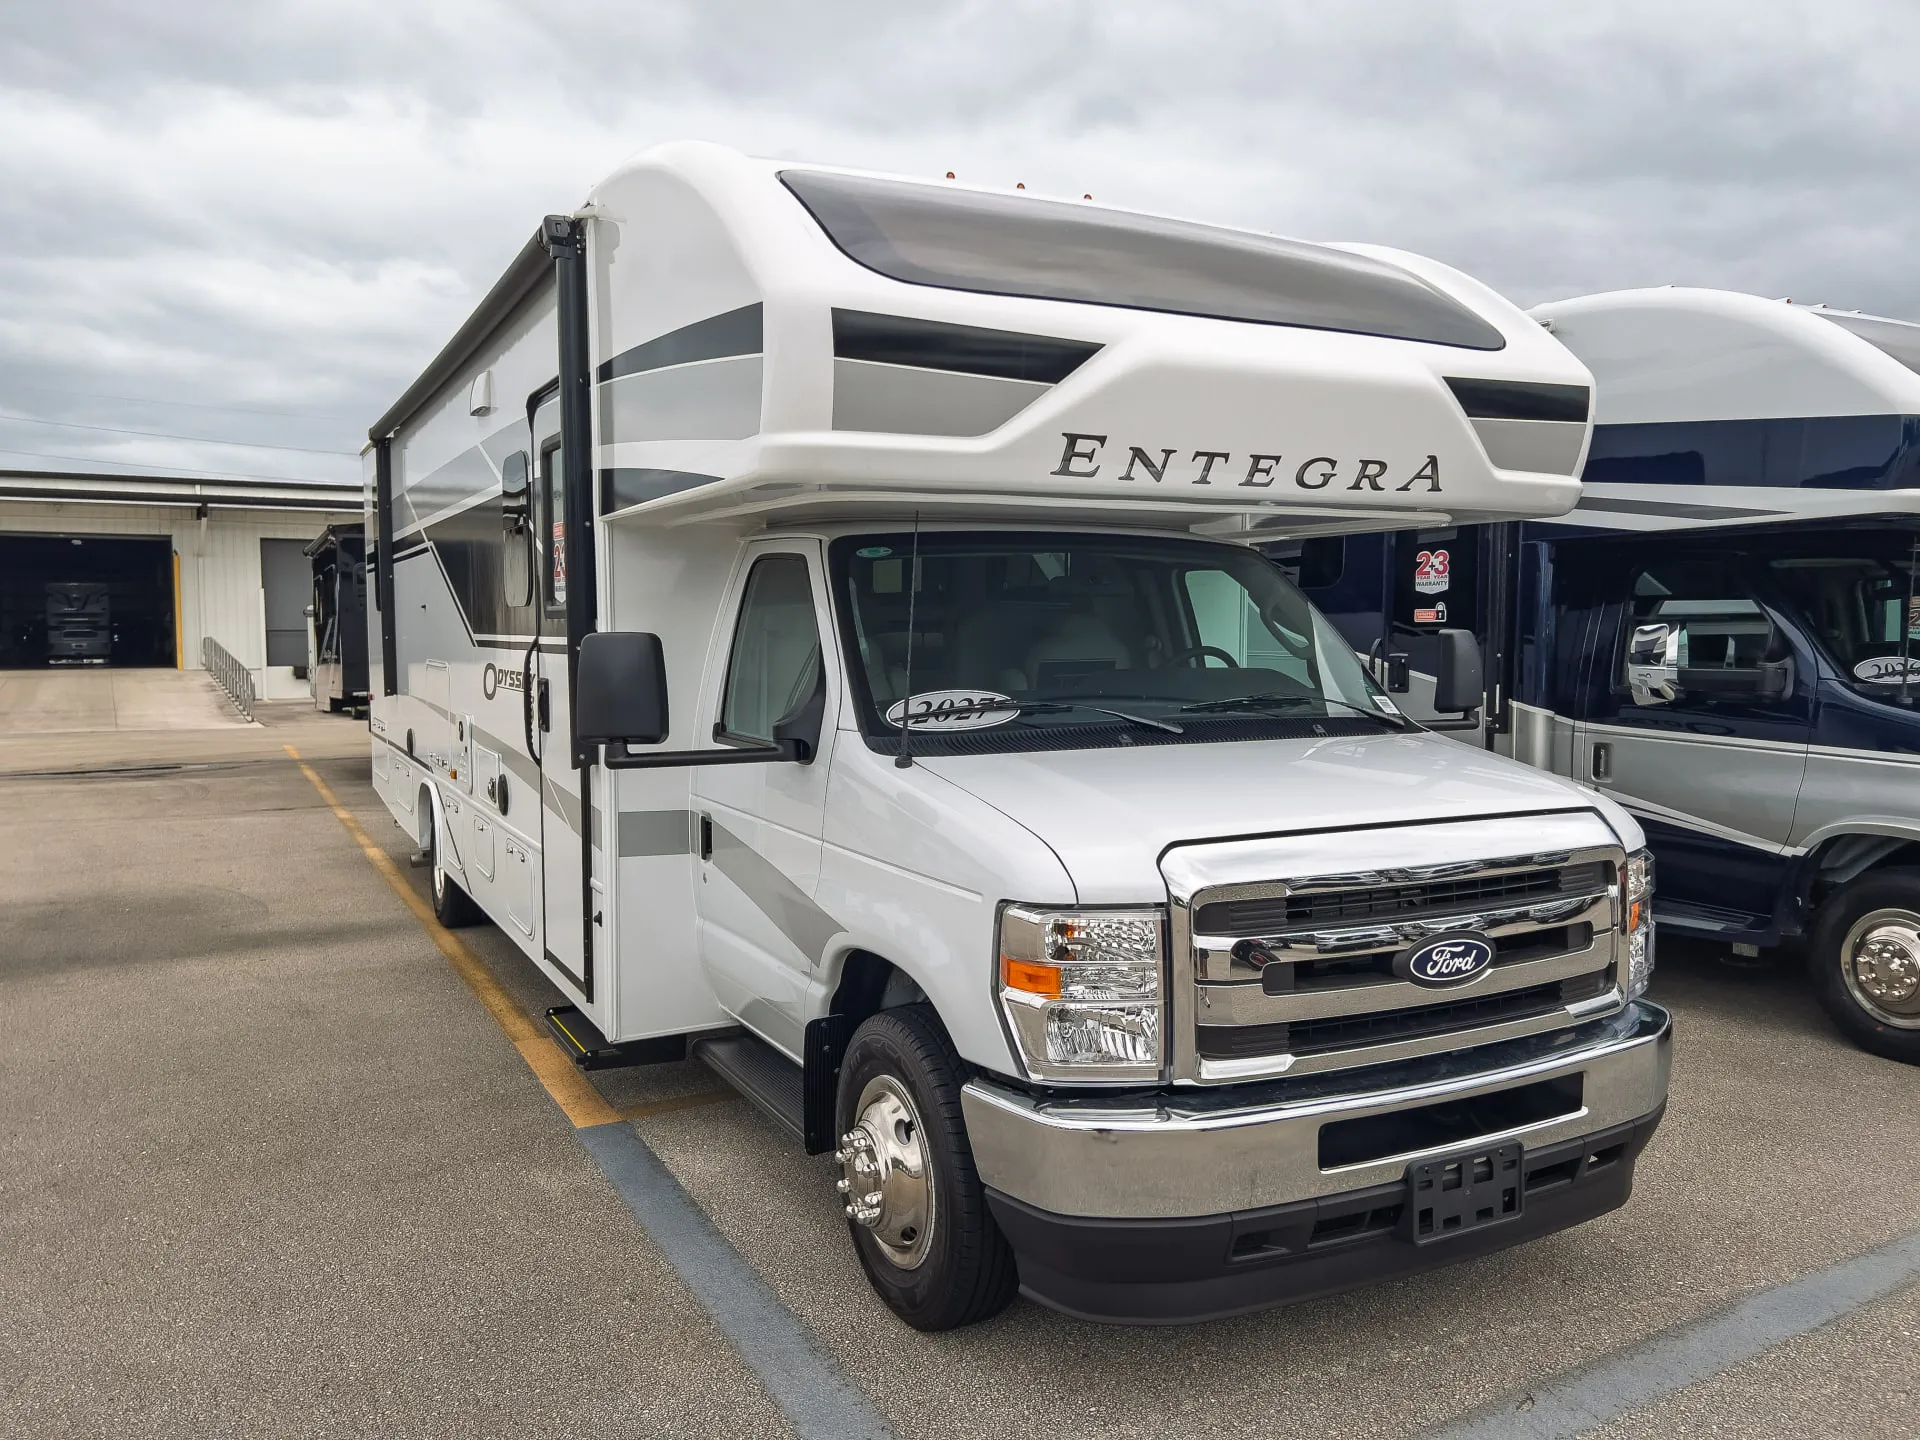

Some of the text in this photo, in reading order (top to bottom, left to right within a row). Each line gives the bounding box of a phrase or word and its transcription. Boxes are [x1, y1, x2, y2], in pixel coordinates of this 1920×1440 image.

[1049, 432, 1443, 493] ENTEGRA
[1416, 580, 1448, 588] WARRANTY
[483, 662, 536, 700] ODYSS
[1426, 945, 1477, 975] Ford
